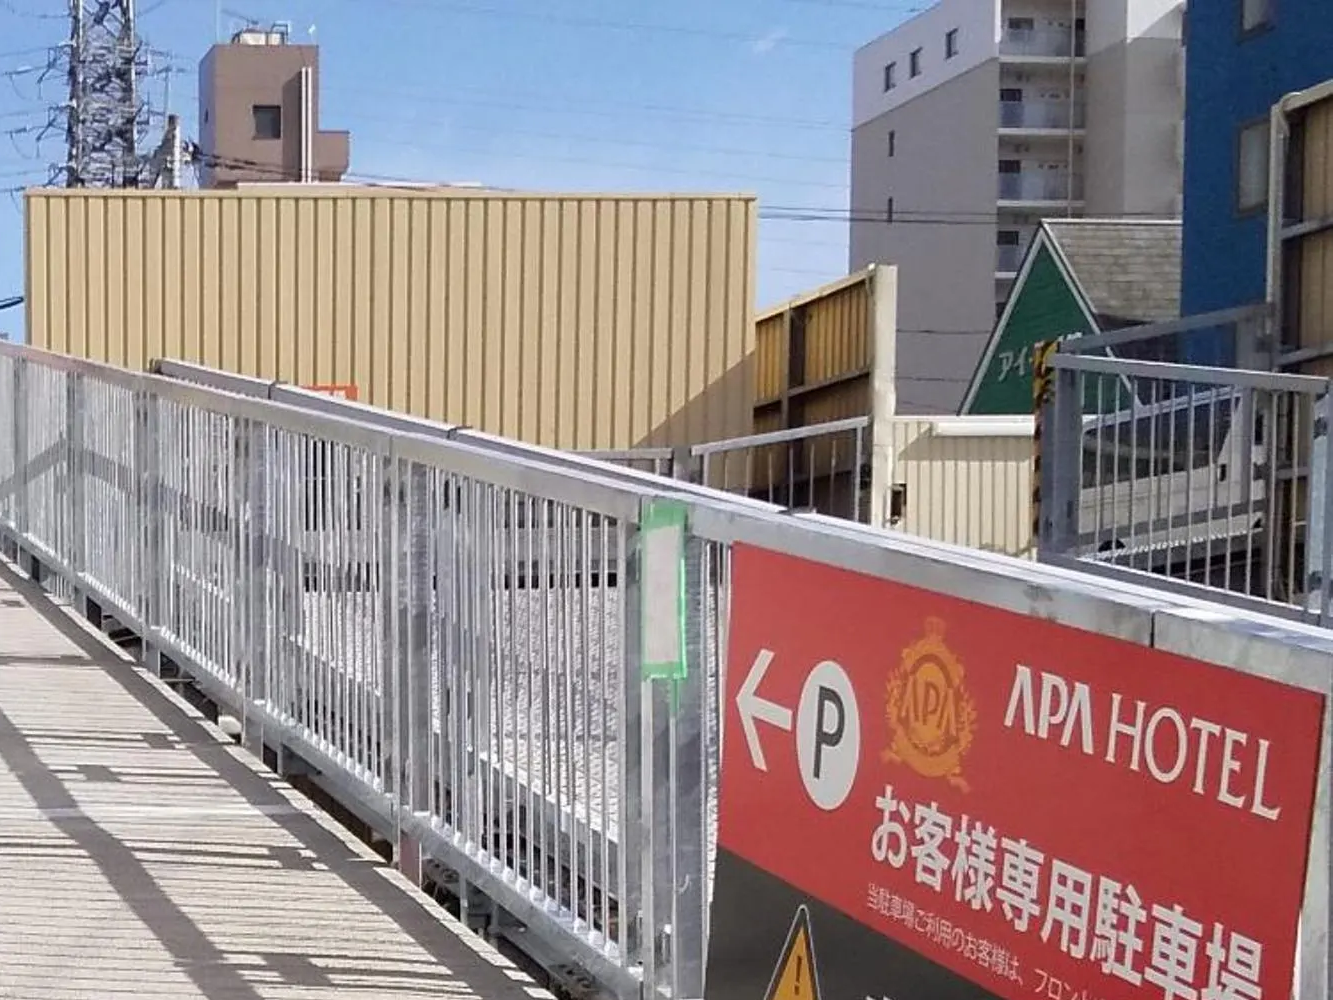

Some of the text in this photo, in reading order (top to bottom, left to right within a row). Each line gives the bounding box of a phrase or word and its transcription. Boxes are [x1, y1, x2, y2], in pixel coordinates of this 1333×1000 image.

[813, 685, 845, 779] P
[900, 670, 957, 738] APA
[1003, 663, 1281, 821] APA HOTEL
